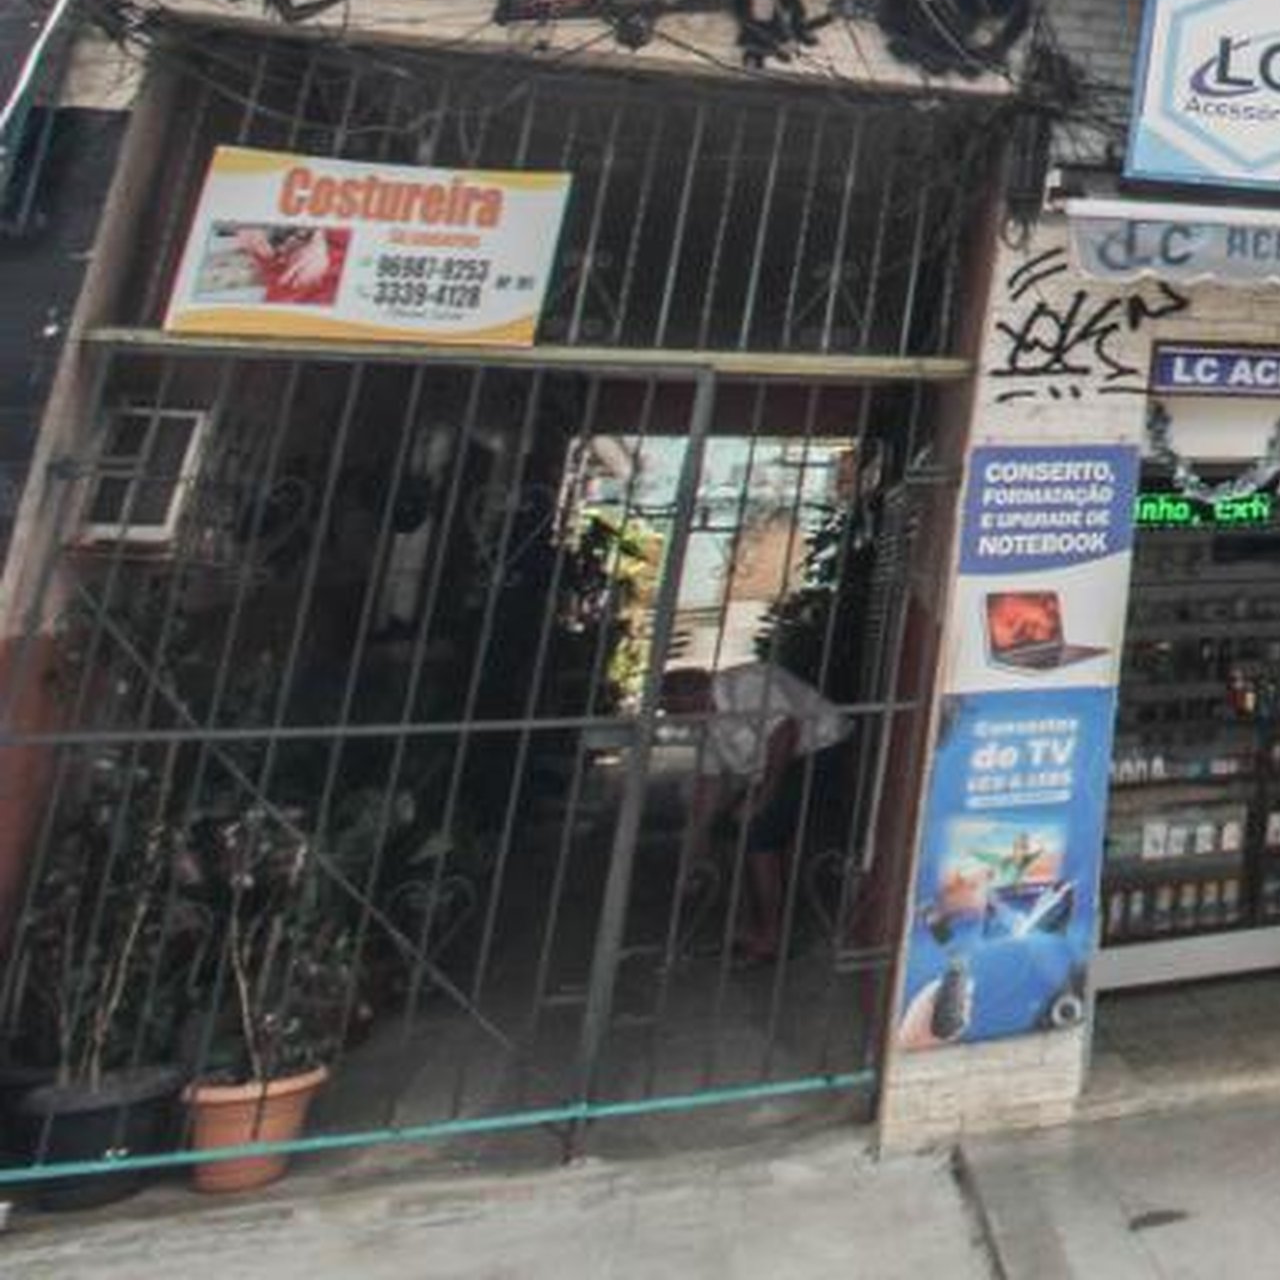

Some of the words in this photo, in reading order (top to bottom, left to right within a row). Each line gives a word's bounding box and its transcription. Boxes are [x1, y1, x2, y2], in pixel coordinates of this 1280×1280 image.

[278, 166, 503, 228] Costureira
[1172, 356, 1219, 384] LC
[978, 531, 1109, 558] NOTEBOOK
[1027, 737, 1078, 767] TV
